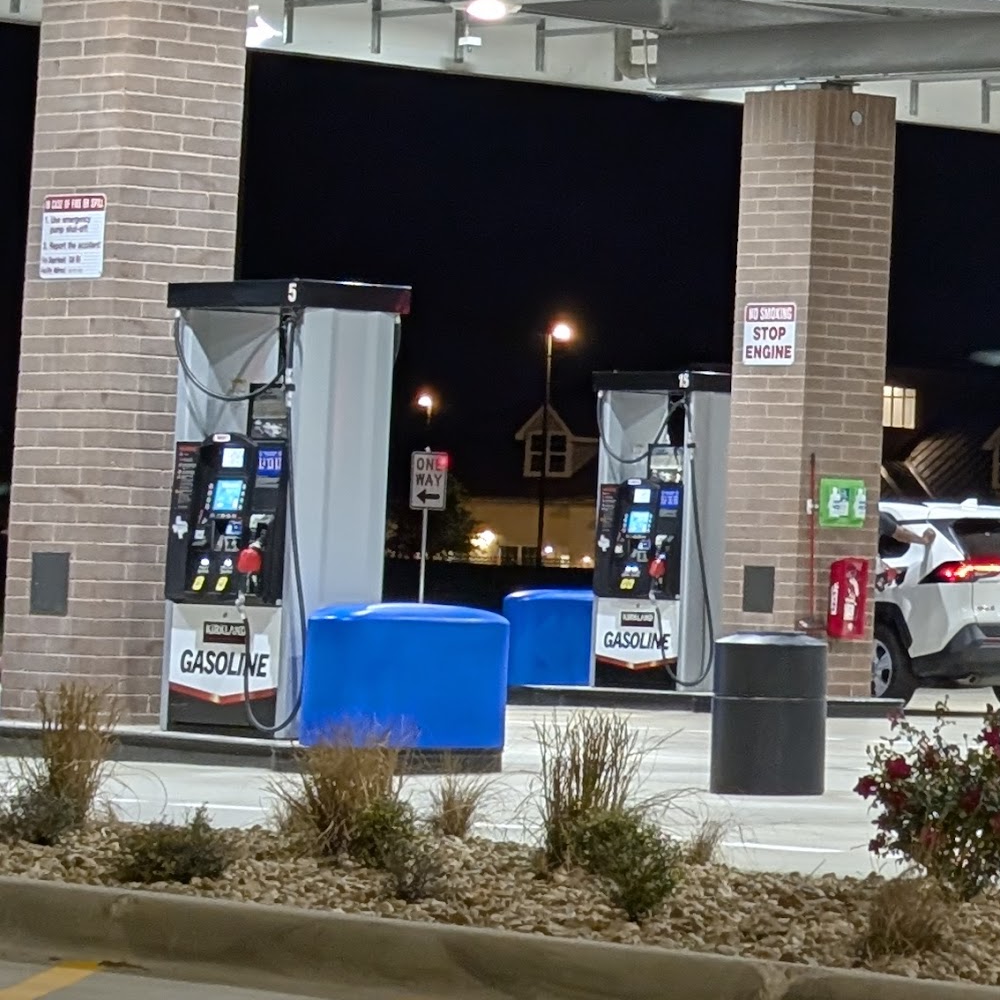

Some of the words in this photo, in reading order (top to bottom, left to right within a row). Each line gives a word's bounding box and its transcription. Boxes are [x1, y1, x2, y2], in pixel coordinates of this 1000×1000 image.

[287, 282, 298, 302] 5
[748, 307, 759, 321] NO
[760, 306, 793, 320] SMOKING
[753, 326, 786, 341] STOP
[745, 344, 792, 359] ENGINE
[416, 474, 442, 487] WAY
[604, 630, 671, 650] GASOLINE
[180, 649, 270, 678] GASOLINE
